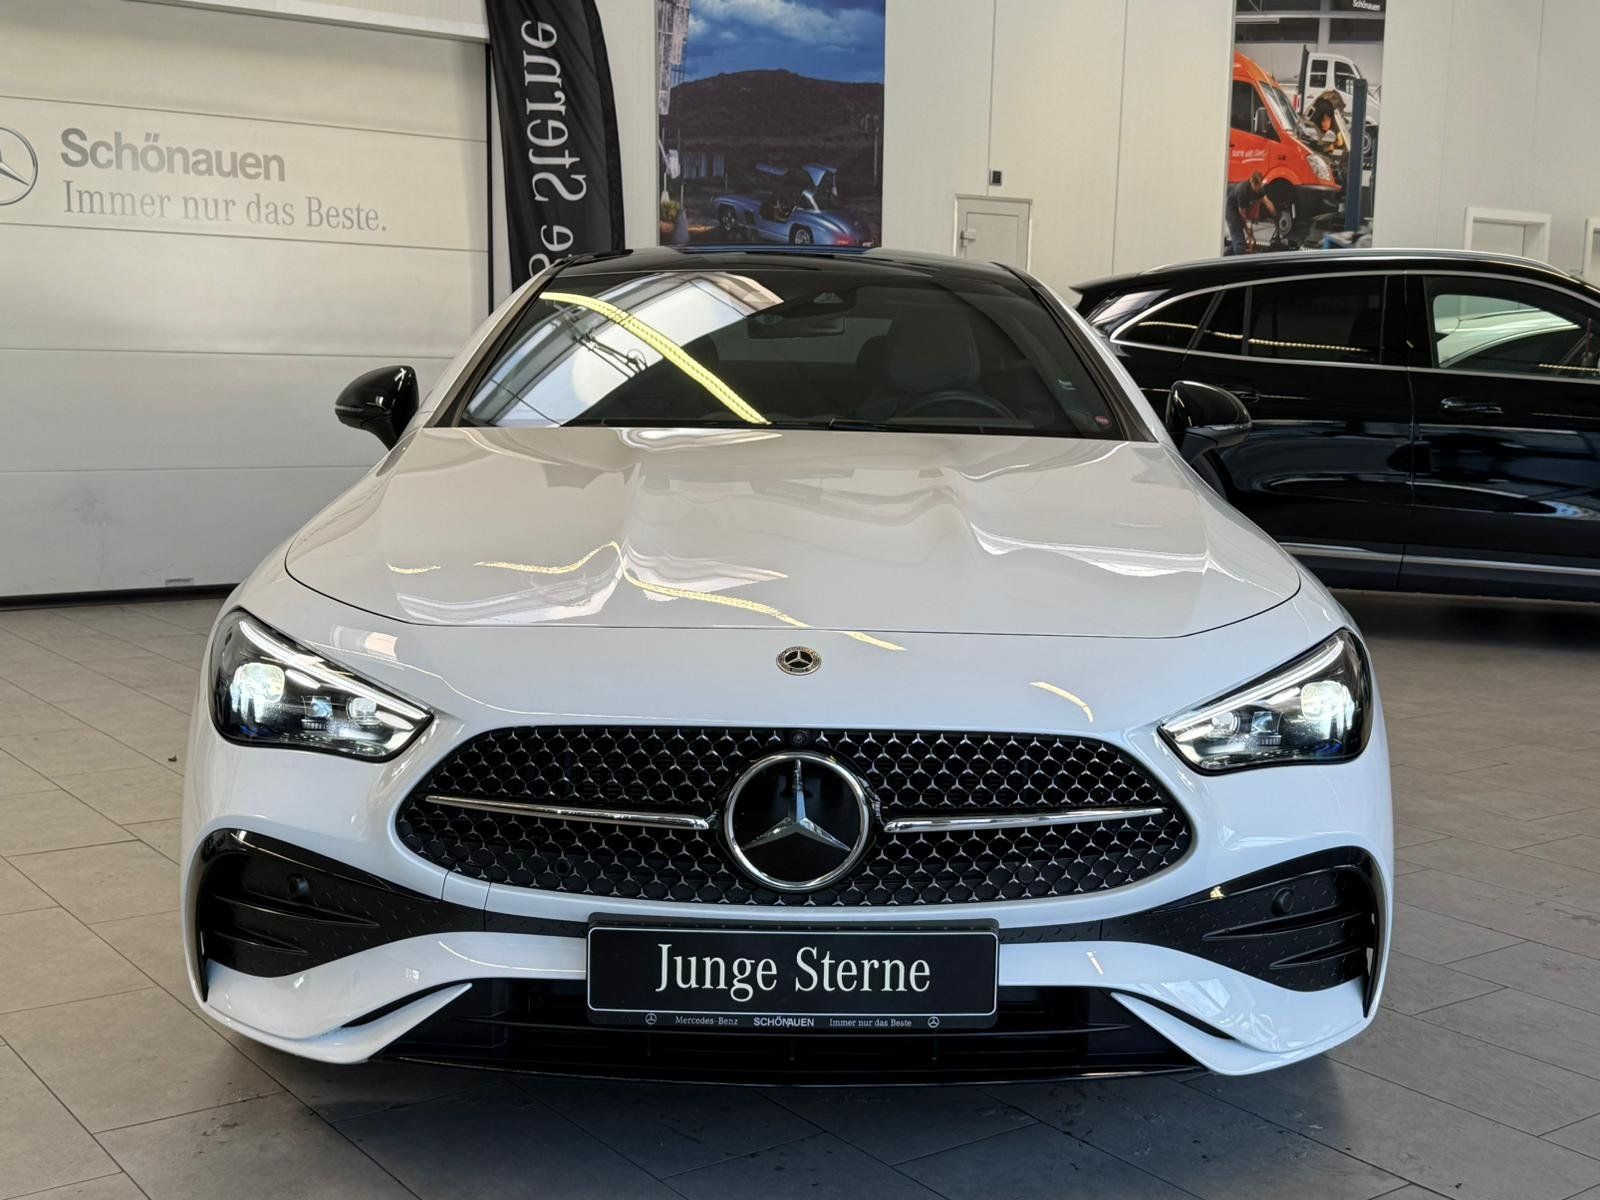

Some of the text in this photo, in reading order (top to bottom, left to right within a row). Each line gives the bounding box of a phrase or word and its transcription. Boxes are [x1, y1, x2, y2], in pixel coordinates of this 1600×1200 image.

[60, 127, 286, 182] Schönauen
[63, 179, 387, 232] Immer nur das Beste.
[655, 943, 931, 1002] Junge Sterne
[674, 1015, 912, 1028] Mercedes-Benz SCHÖNAUEN Immer nur das Beste
